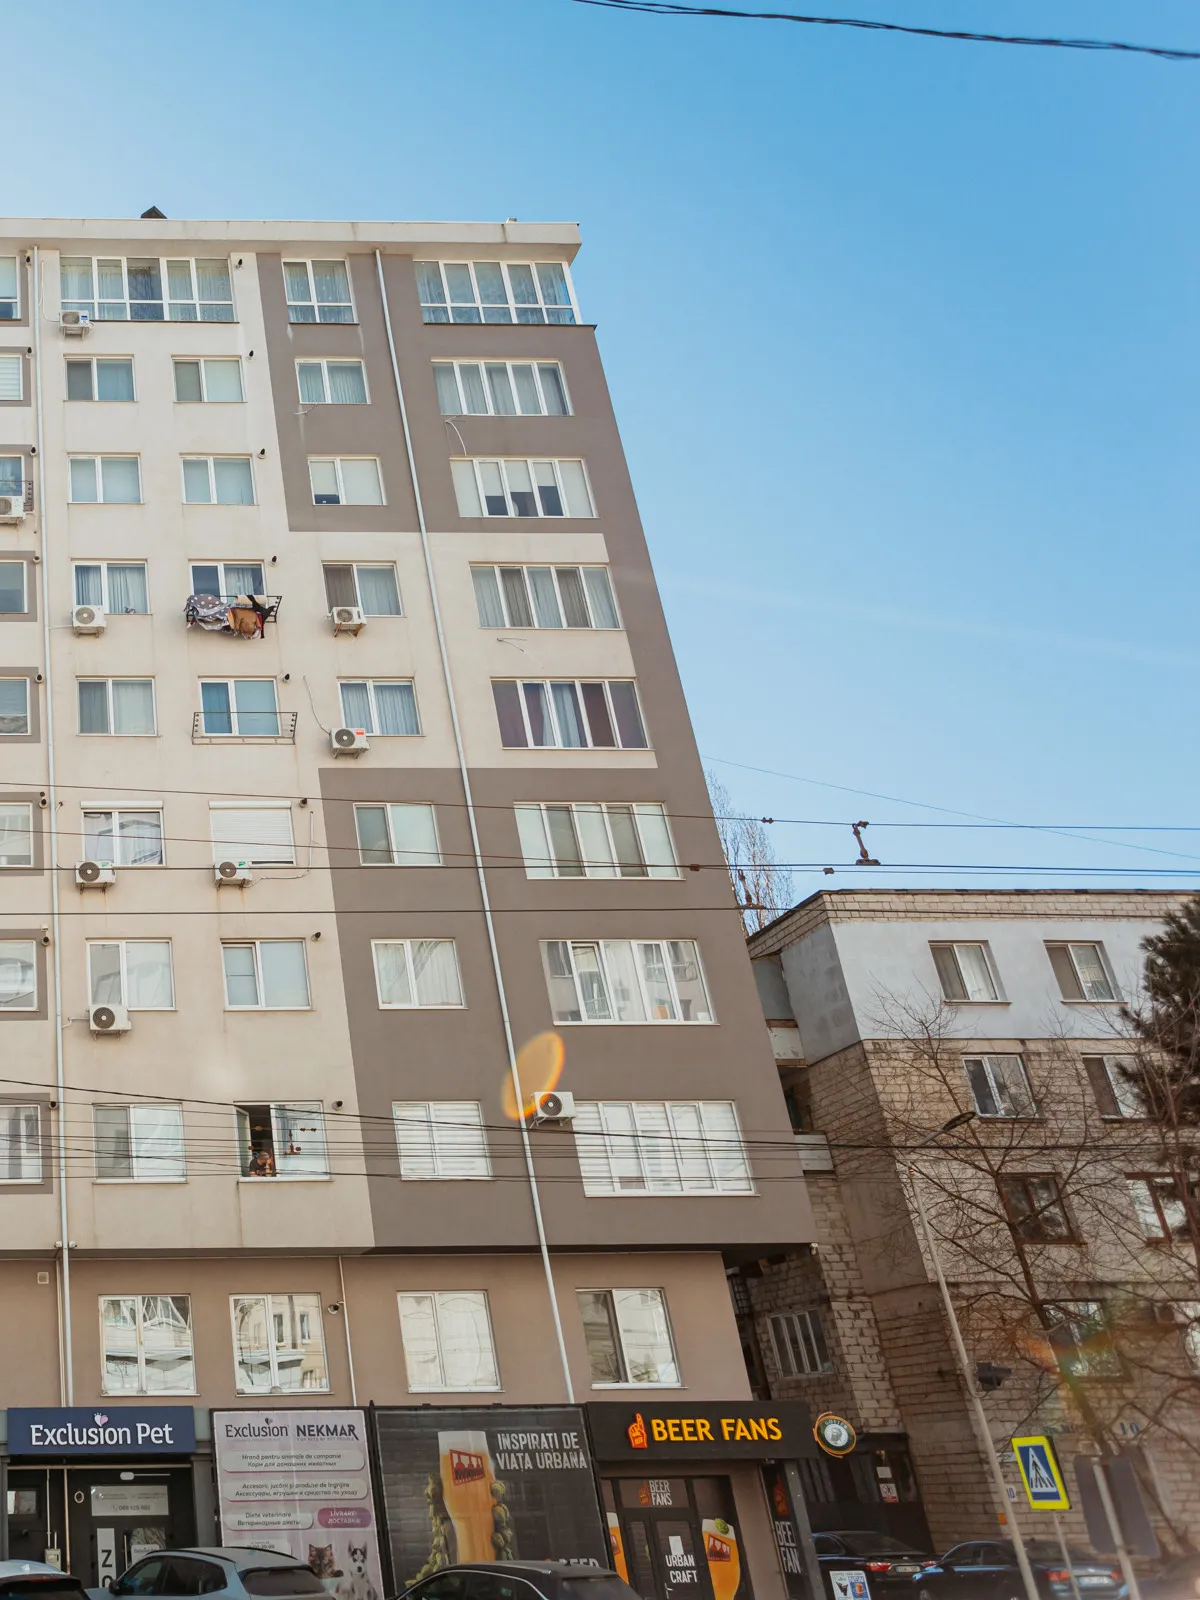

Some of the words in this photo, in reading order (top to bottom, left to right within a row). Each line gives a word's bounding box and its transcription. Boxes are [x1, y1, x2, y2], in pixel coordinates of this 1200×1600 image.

[30, 1422, 131, 1446] Exclusion
[135, 1422, 174, 1445] Pet
[225, 1423, 289, 1438] Exclusion
[296, 1424, 359, 1441] NEKMAR
[651, 1418, 715, 1442] BEER
[720, 1418, 782, 1441] FANS
[562, 1432, 580, 1449] DE
[648, 1479, 670, 1493] BEER
[651, 1492, 673, 1506] FANS
[774, 1520, 797, 1547] BEE
[665, 1554, 696, 1568] URBAN
[780, 1547, 802, 1574] FAN
[669, 1570, 698, 1583] CRAFT
